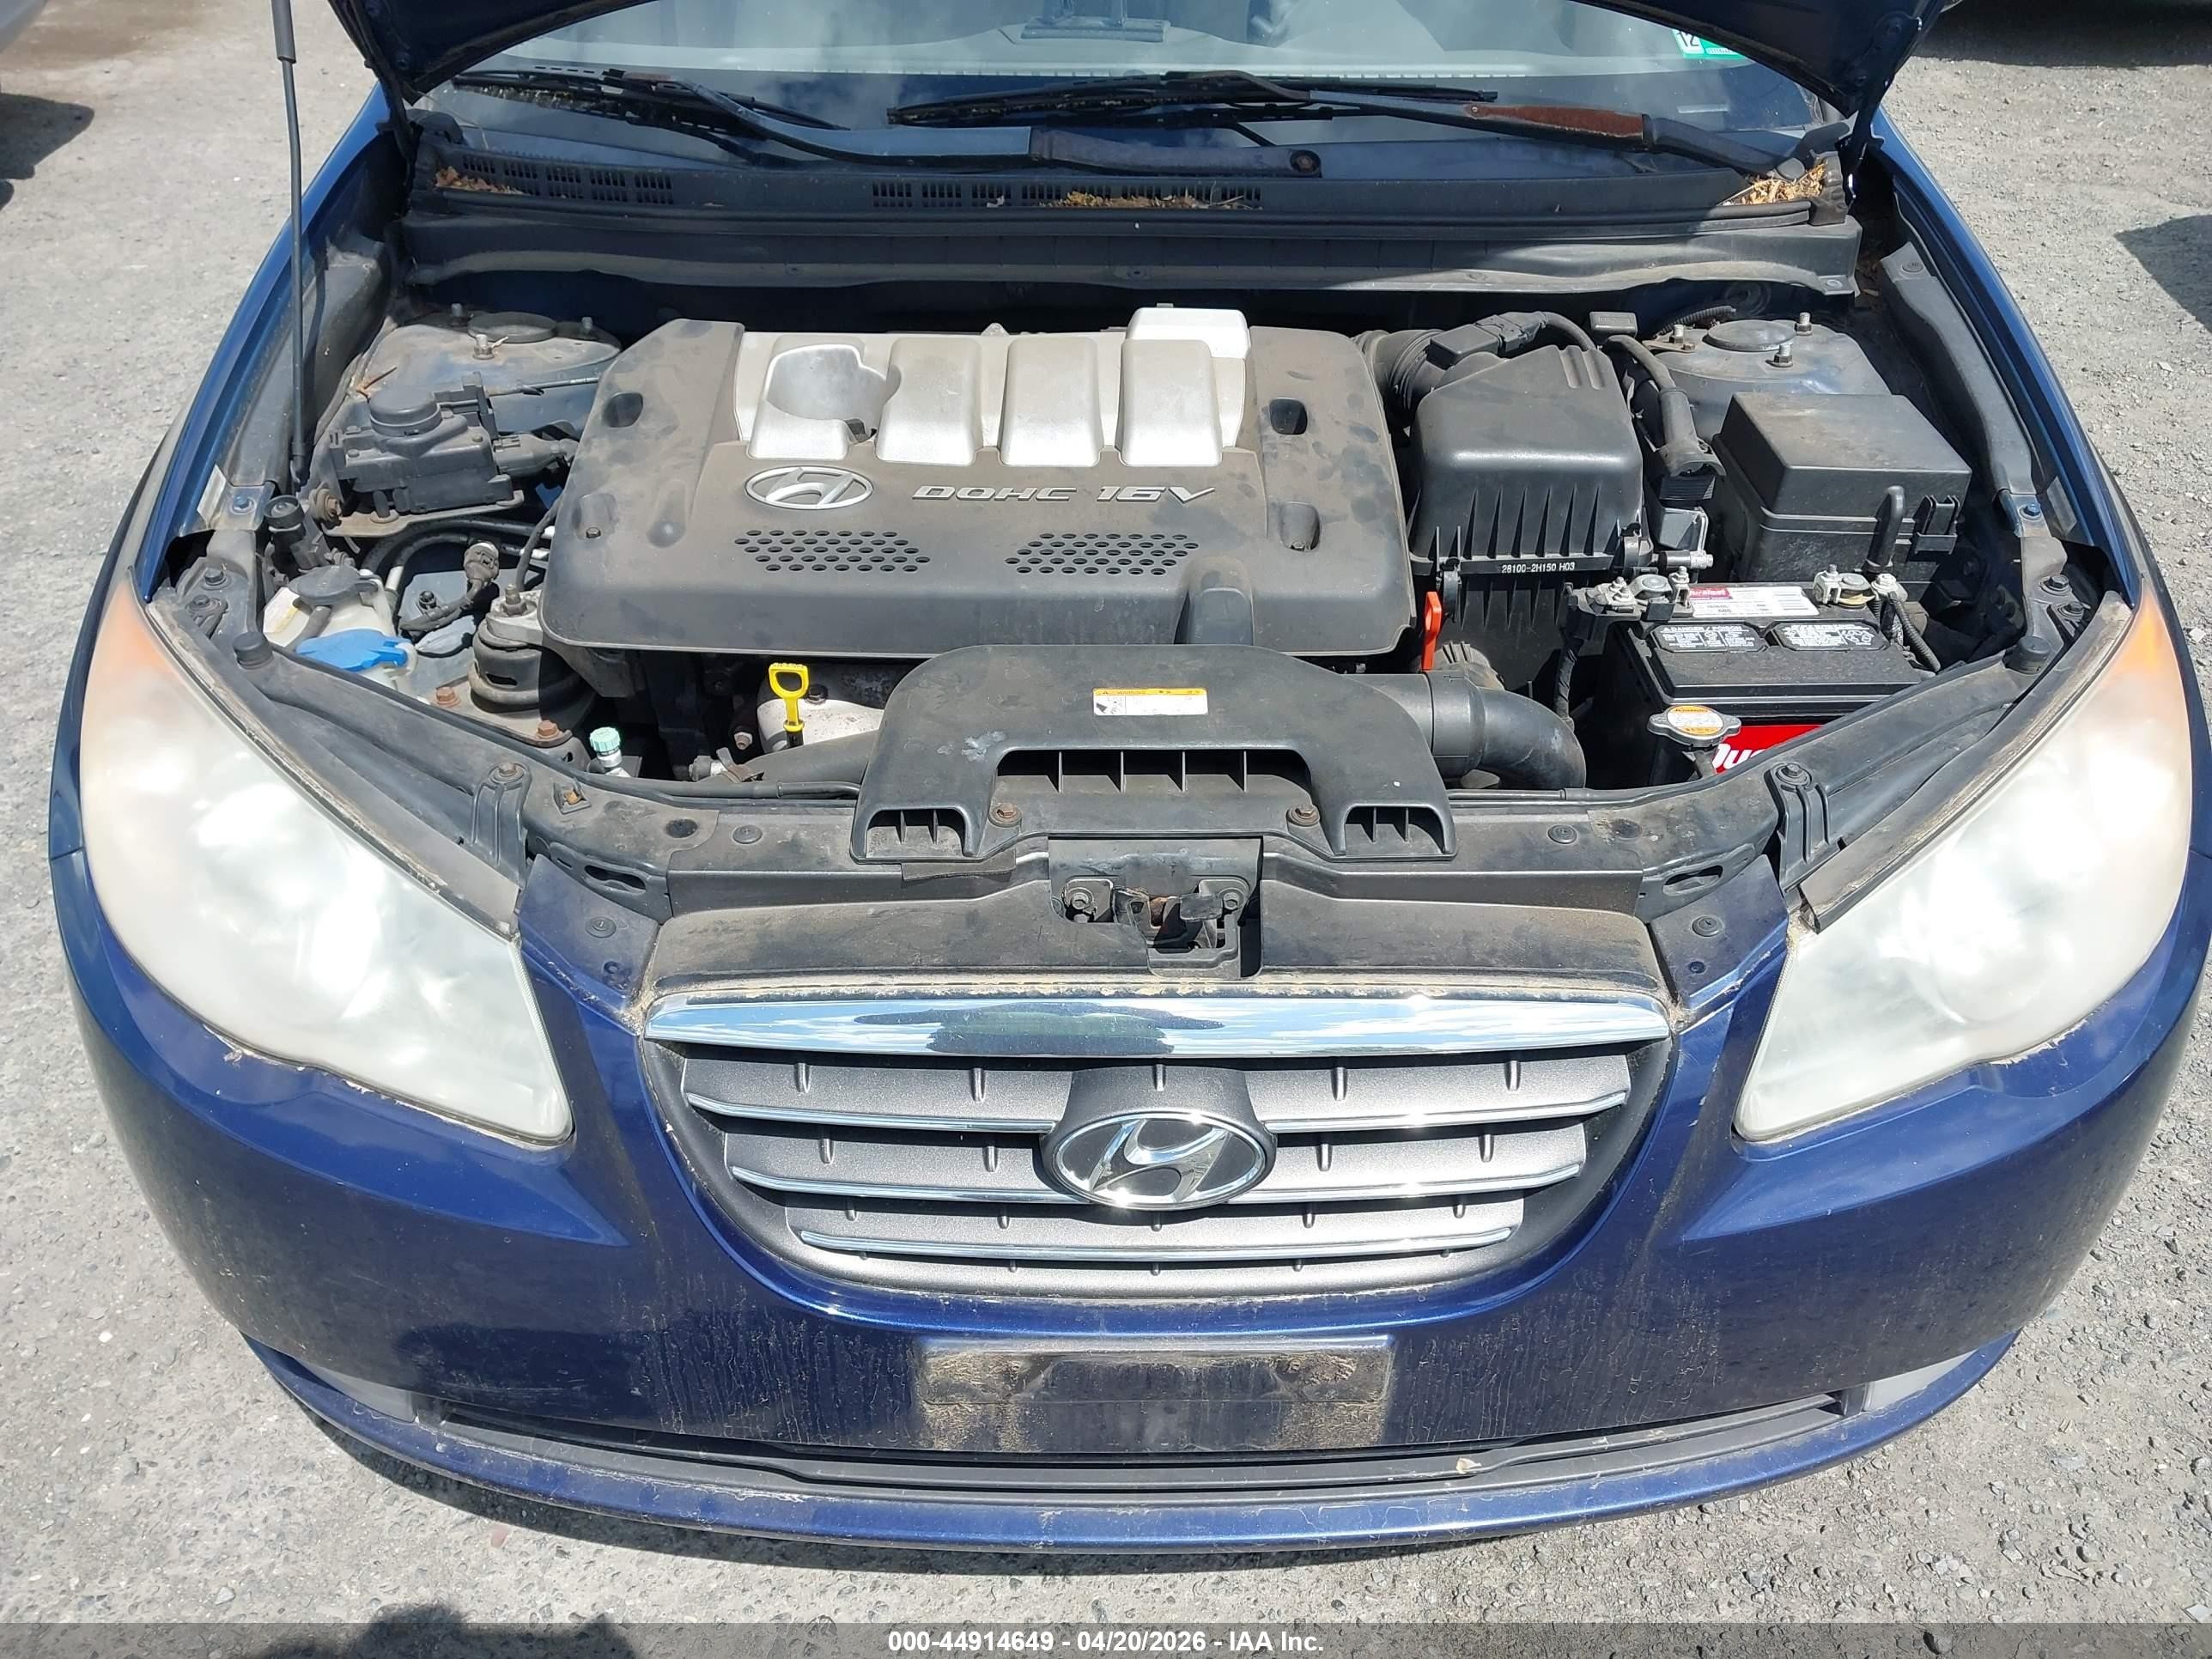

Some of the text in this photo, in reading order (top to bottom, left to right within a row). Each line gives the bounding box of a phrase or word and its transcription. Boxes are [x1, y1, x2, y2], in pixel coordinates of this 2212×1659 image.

[912, 485, 1215, 504] DOHC 16V
[1501, 562, 1576, 574] 28100-2H150 H03
